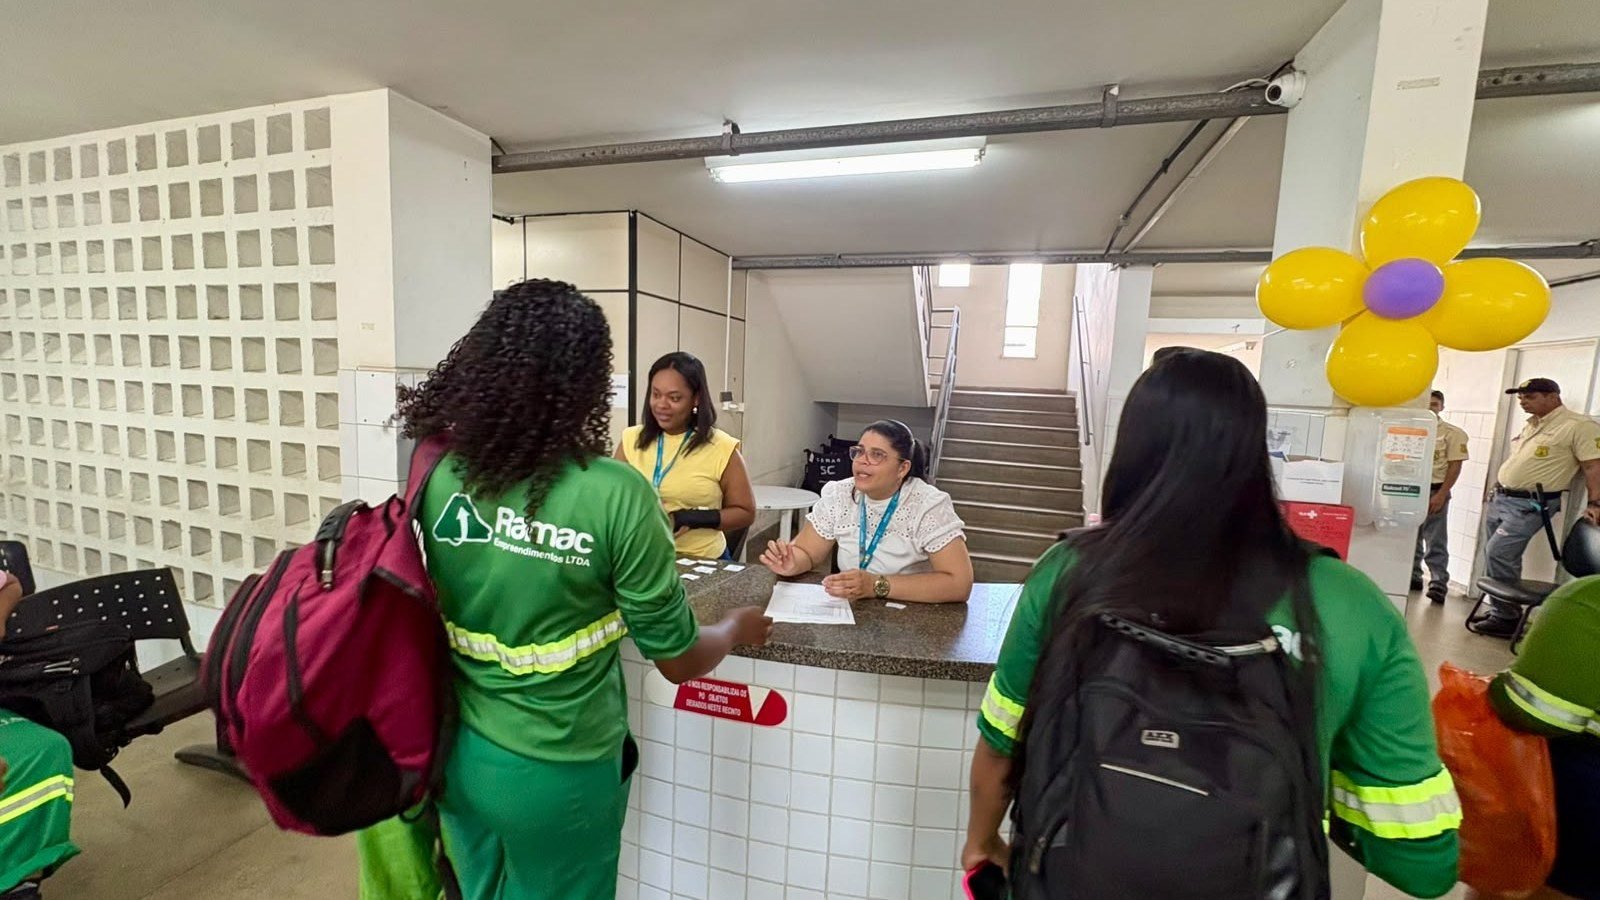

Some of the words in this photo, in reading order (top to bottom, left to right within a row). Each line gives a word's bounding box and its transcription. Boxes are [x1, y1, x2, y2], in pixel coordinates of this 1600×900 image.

[820, 465, 836, 475] SC
[495, 506, 594, 554] Ramac
[493, 537, 564, 564] Empreendimentos
[565, 555, 591, 567] LTDA
[708, 693, 729, 704] OBJETOS
